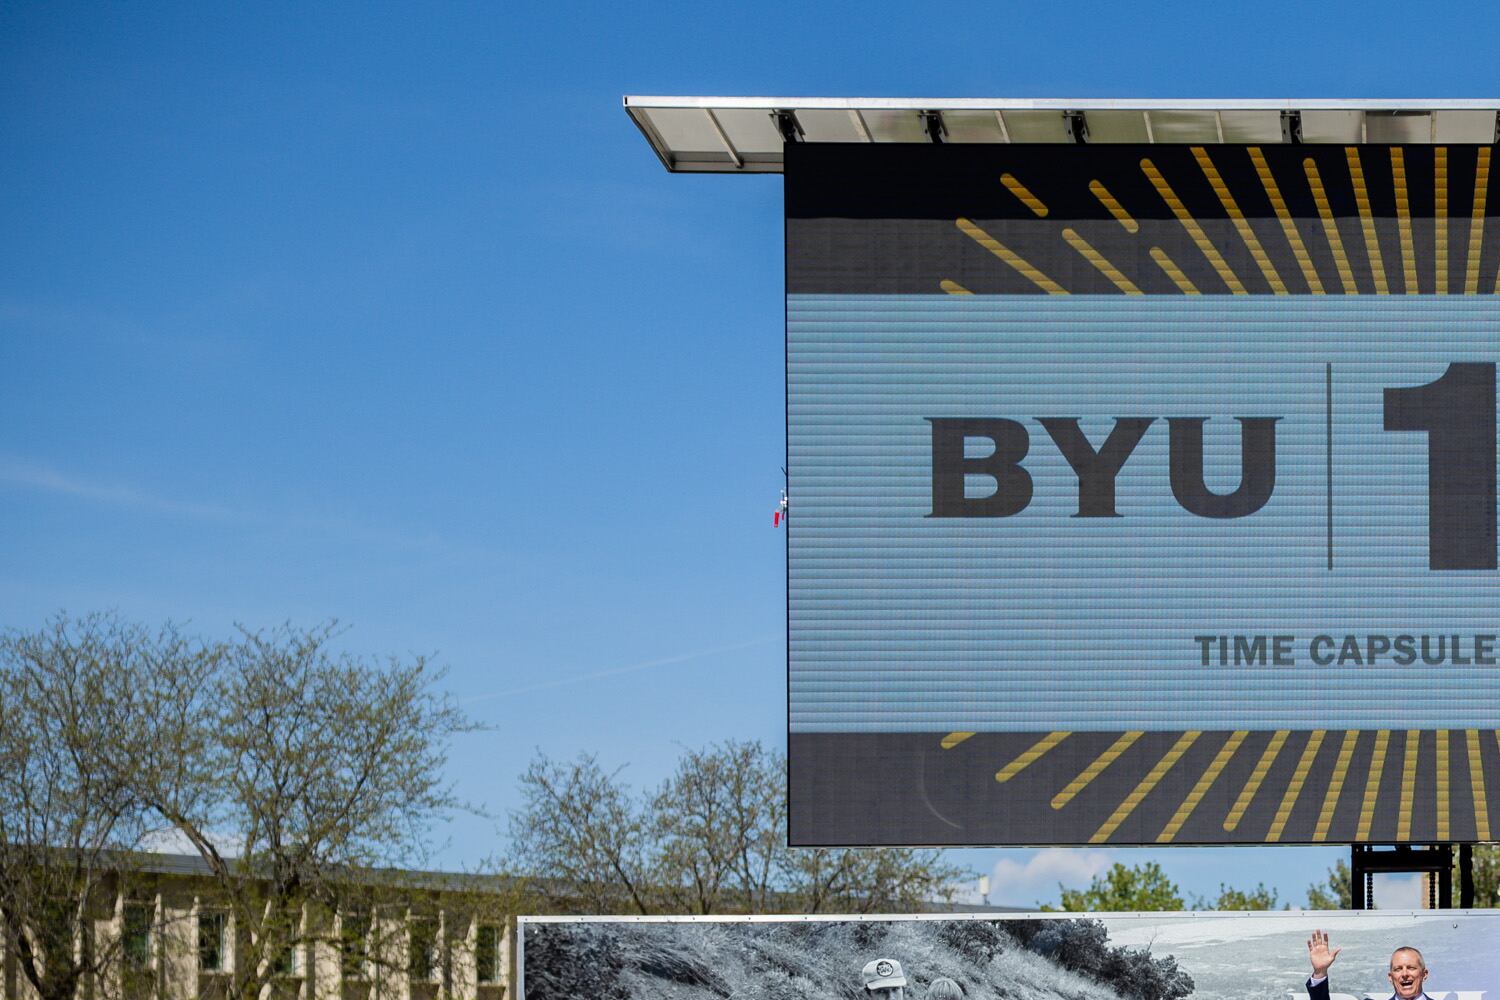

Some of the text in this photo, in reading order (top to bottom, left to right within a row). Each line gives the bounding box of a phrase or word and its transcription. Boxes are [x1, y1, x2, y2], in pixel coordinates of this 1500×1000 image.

[923, 416, 1283, 518] BYU
[1194, 634, 1295, 665] TIME
[1309, 634, 1496, 666] CAPSULE
